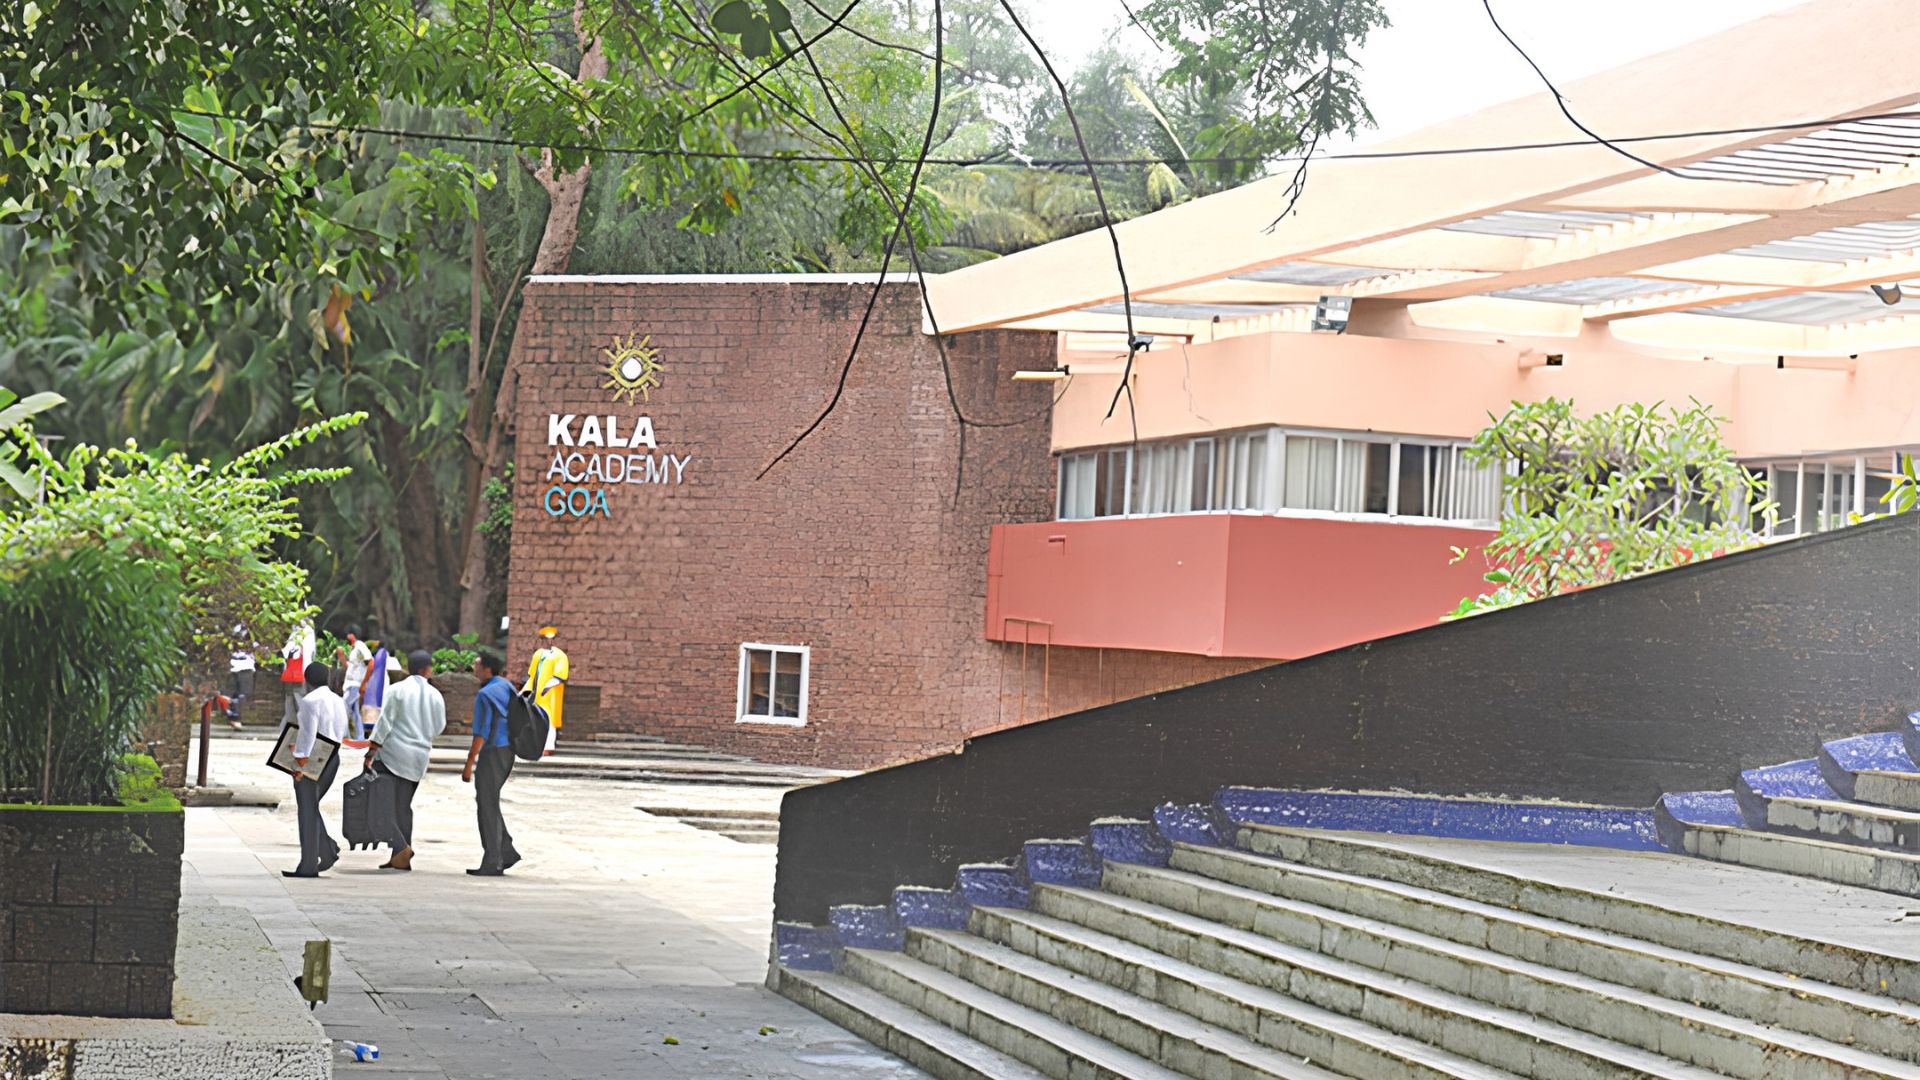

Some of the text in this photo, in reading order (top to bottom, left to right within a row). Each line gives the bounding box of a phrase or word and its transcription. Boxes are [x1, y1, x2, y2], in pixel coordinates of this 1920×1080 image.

[548, 413, 657, 449] KALA
[546, 450, 692, 485] ACADEMY
[544, 486, 611, 518] GOA
